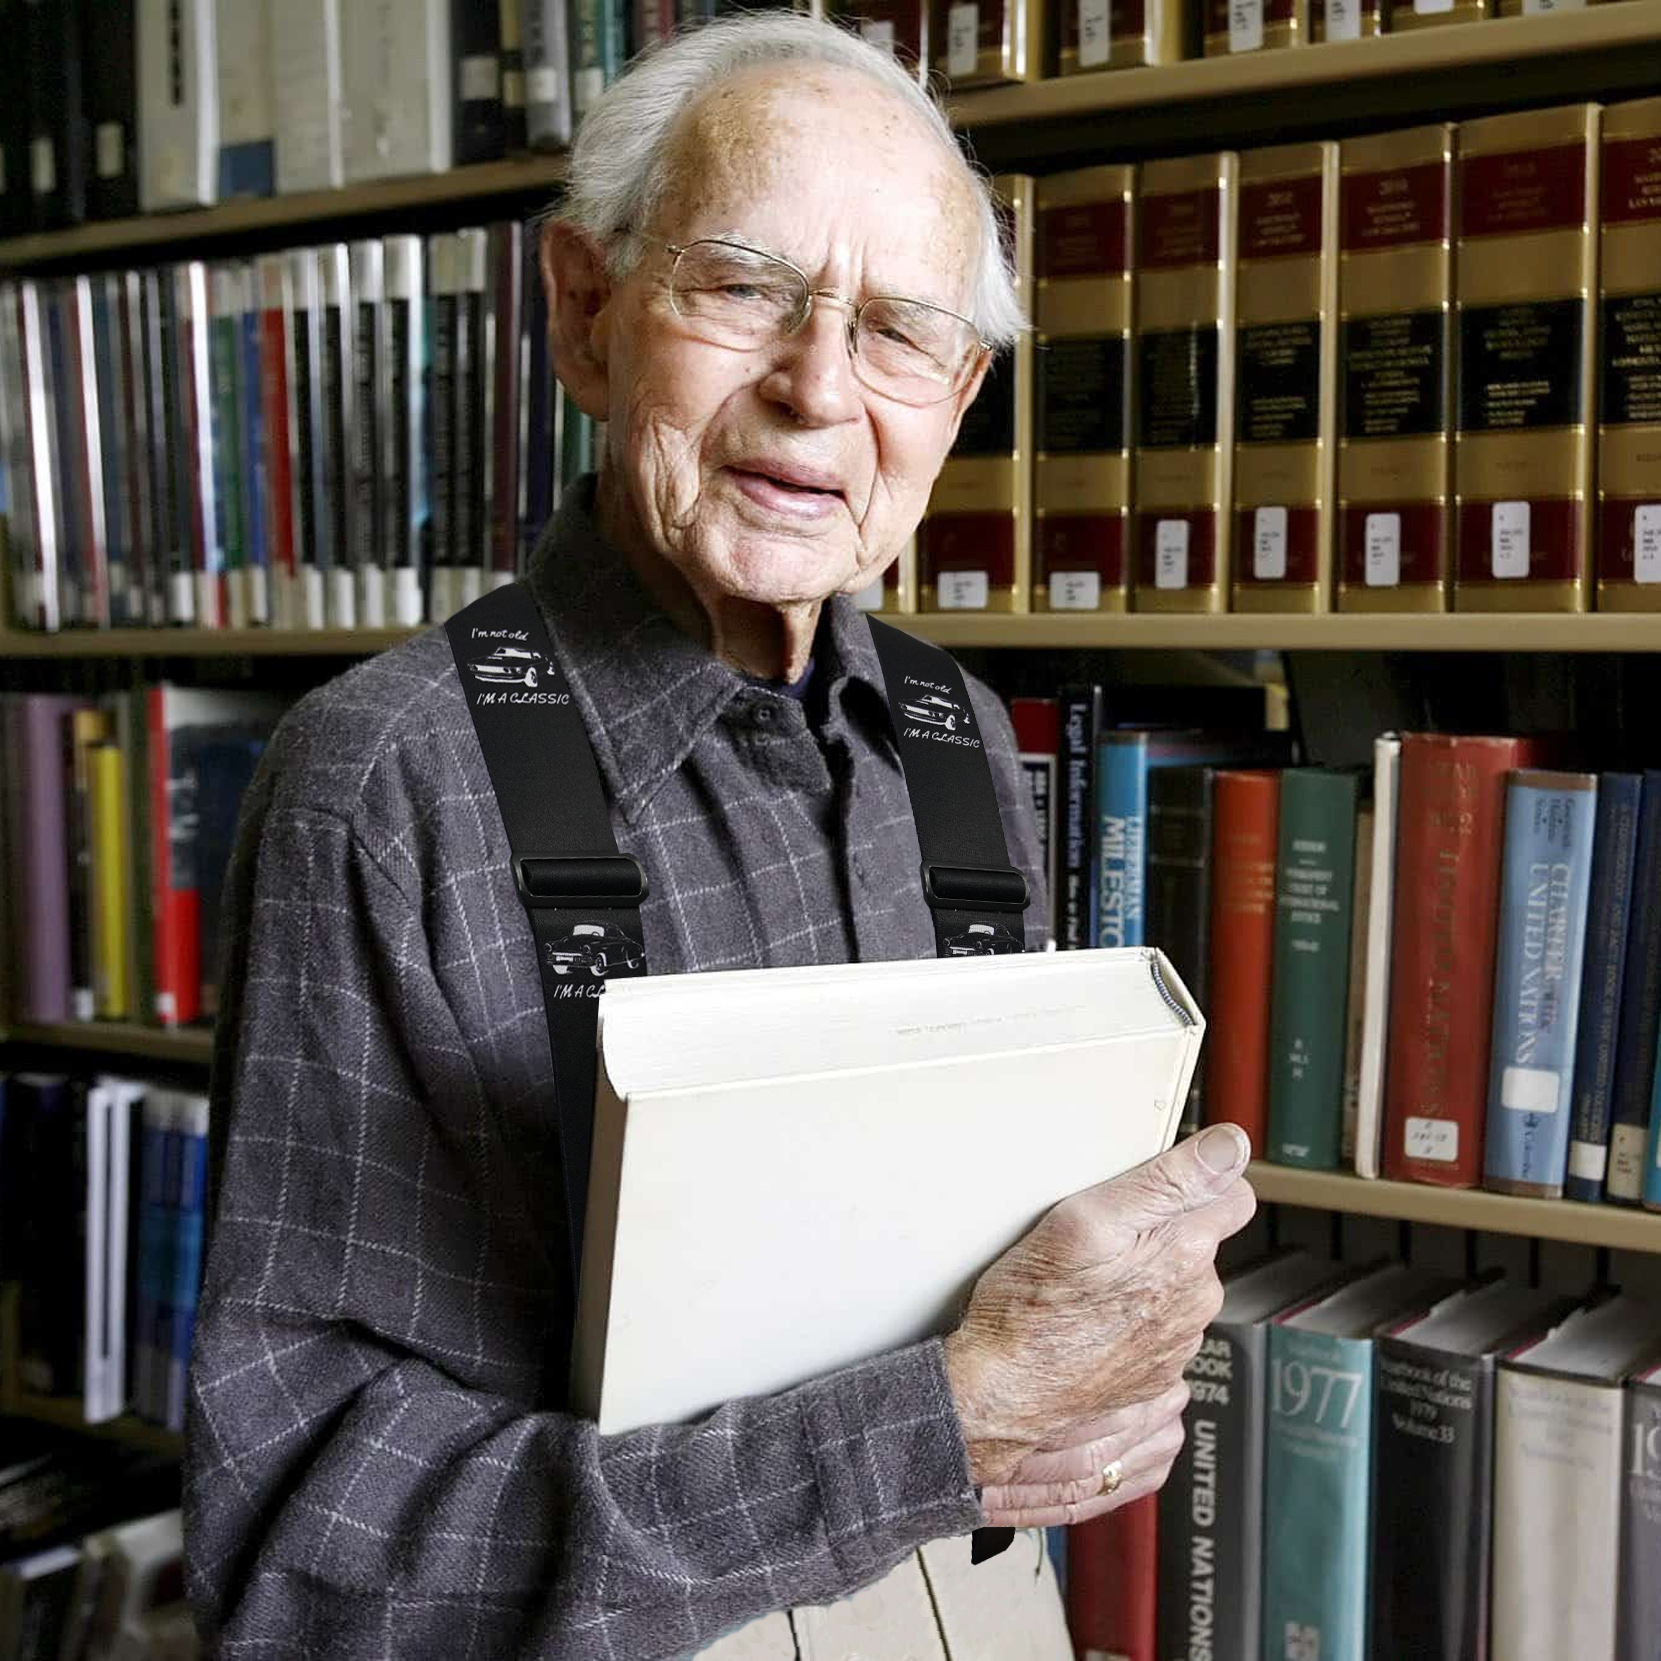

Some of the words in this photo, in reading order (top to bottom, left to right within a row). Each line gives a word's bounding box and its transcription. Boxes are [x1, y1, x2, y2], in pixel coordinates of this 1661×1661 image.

[471, 628, 488, 638] I'm
[490, 629, 507, 638] not
[508, 630, 529, 640] old
[904, 675, 919, 685] I'm
[920, 680, 935, 689] not
[935, 684, 952, 694] old
[477, 692, 496, 705] I'M
[497, 692, 507, 703] A
[509, 692, 569, 705] CLASSIC
[904, 727, 920, 738] I'M
[922, 730, 930, 739] A
[931, 731, 980, 748] CLASSIC
[1066, 703, 1087, 753] Legal
[1524, 863, 1549, 961] UNITED
[554, 984, 573, 999] I'M
[575, 984, 584, 998] A
[1188, 1356, 1233, 1380] OOK
[1188, 1379, 1230, 1406] 974
[1272, 1357, 1363, 1429] 1977
[1191, 1418, 1217, 1528] UNITED
[1188, 1535, 1216, 1661] NATIONS
